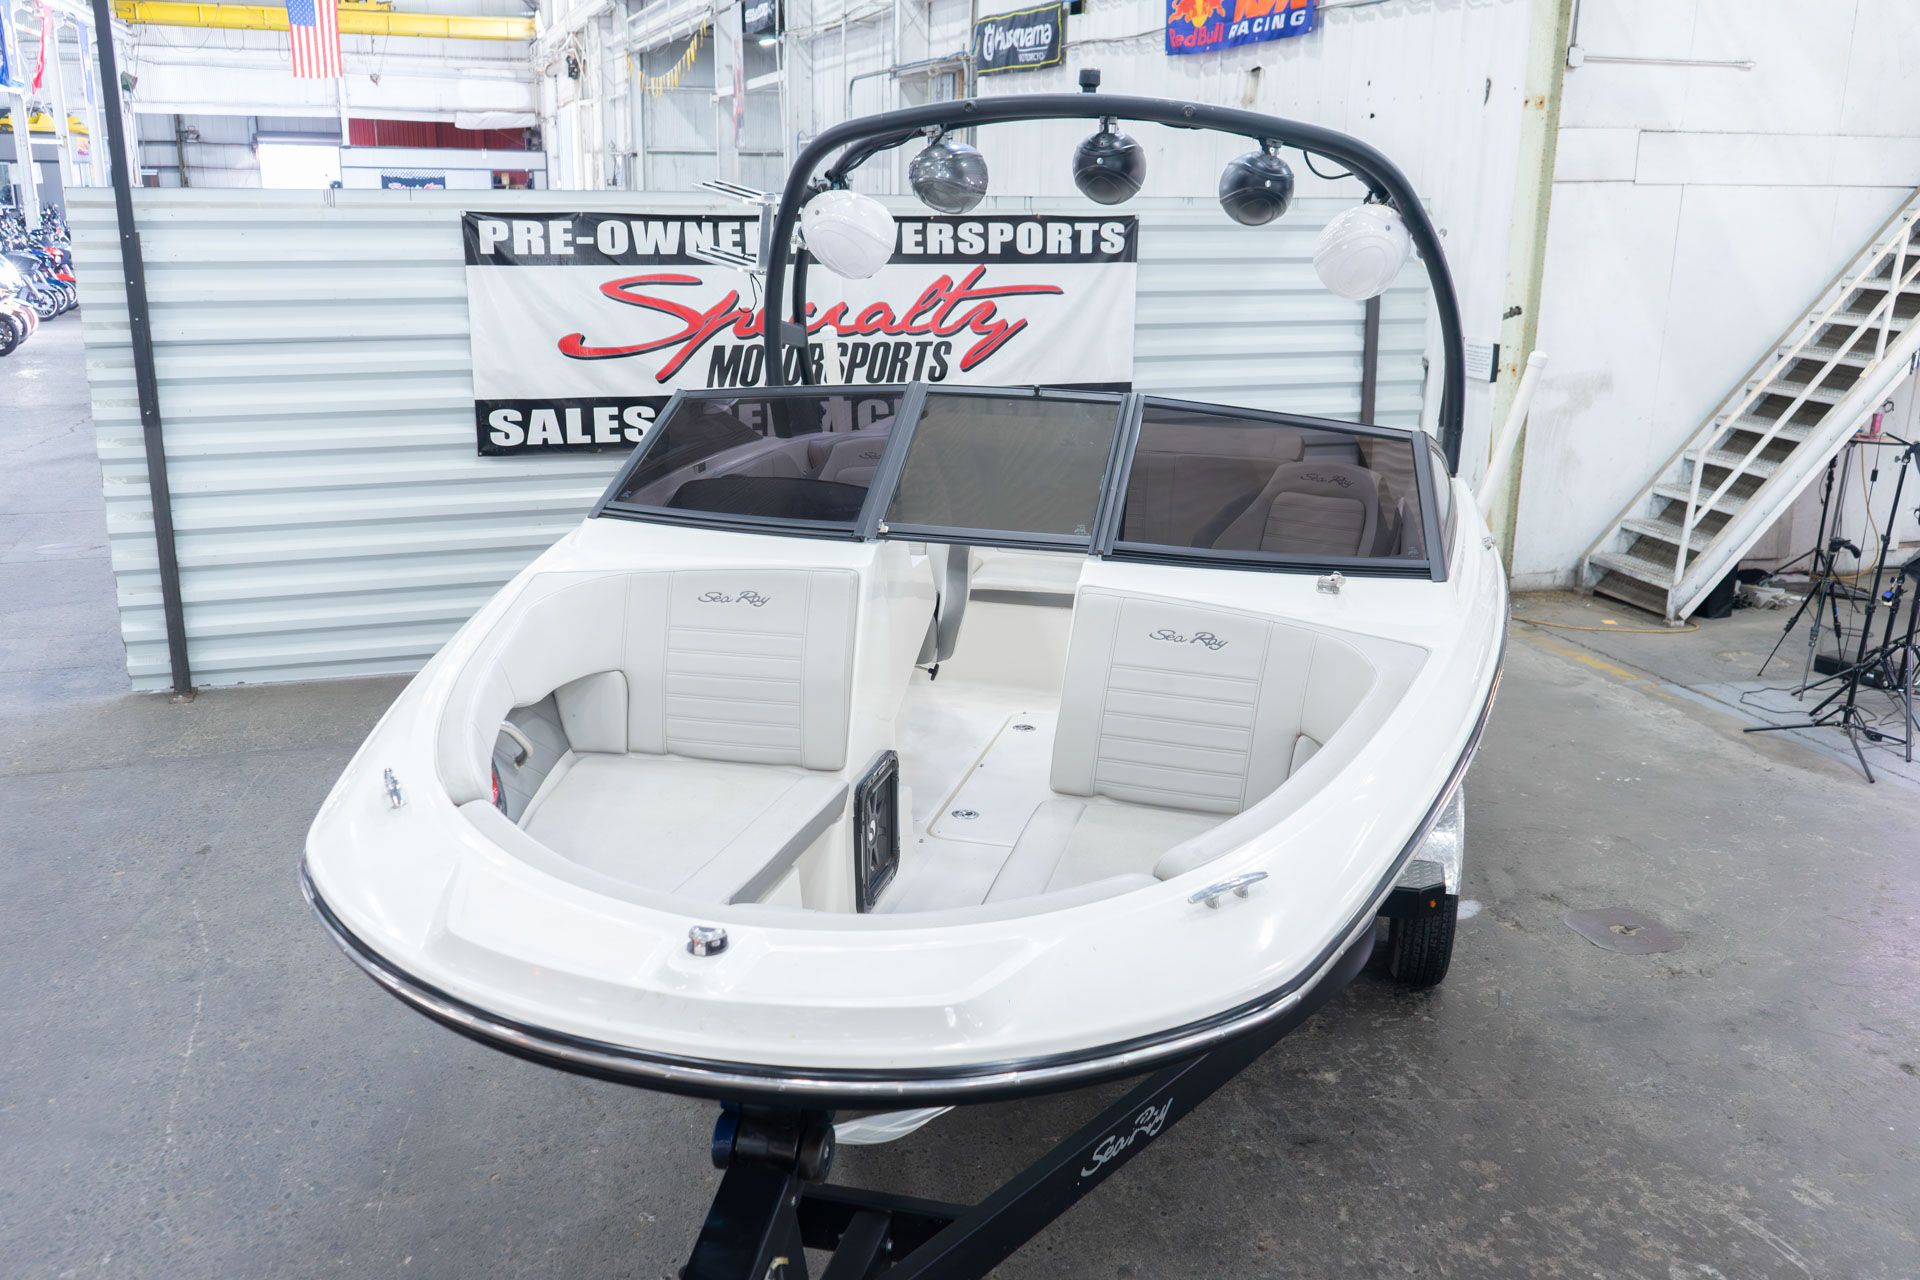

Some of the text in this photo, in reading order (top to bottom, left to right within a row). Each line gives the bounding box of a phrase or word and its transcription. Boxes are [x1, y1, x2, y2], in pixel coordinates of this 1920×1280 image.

[1228, 9, 1307, 40] RACING
[488, 405, 656, 447] SALES
[698, 590, 771, 607] Sea Ray
[1149, 629, 1228, 650] Sea Ray
[1081, 1135, 1131, 1177] Sea
